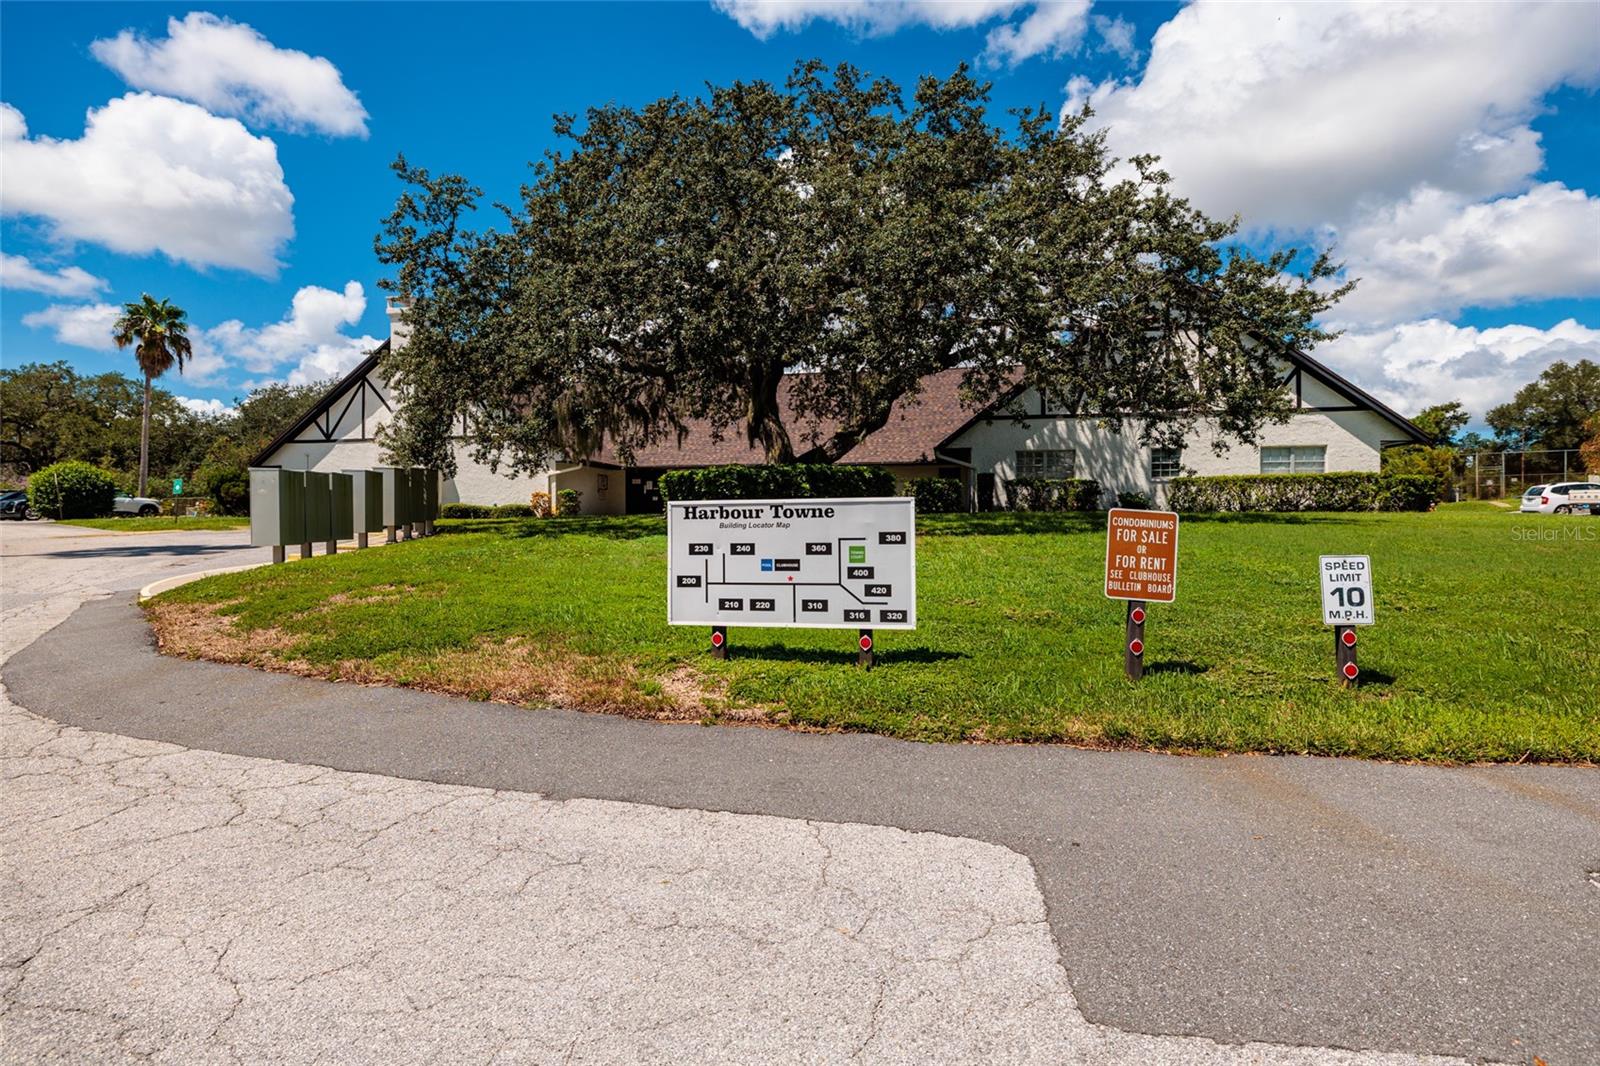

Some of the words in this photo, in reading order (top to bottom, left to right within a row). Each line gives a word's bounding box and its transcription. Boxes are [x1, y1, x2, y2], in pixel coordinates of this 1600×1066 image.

[683, 505, 764, 520] Harbour
[769, 504, 835, 519] Towne
[1112, 517, 1174, 530] CONDOMINIUMS
[885, 534, 901, 542] 380
[1116, 528, 1137, 542] FOR
[1141, 530, 1169, 544] SALE
[1136, 545, 1147, 554] OR
[1115, 555, 1136, 569] FOR
[1140, 556, 1167, 570] RENT
[1325, 561, 1365, 571] SPEED
[1110, 569, 1123, 579] SEE
[1129, 570, 1171, 583] CLUBHOUSE
[1329, 573, 1362, 582] LIMIT
[1108, 581, 1141, 591] BULLETIN
[1147, 583, 1172, 594] BOARD
[1330, 587, 1365, 607] 10
[755, 601, 770, 609] 220
[887, 612, 902, 620] 320
[1329, 610, 1368, 619] M.P.H.
